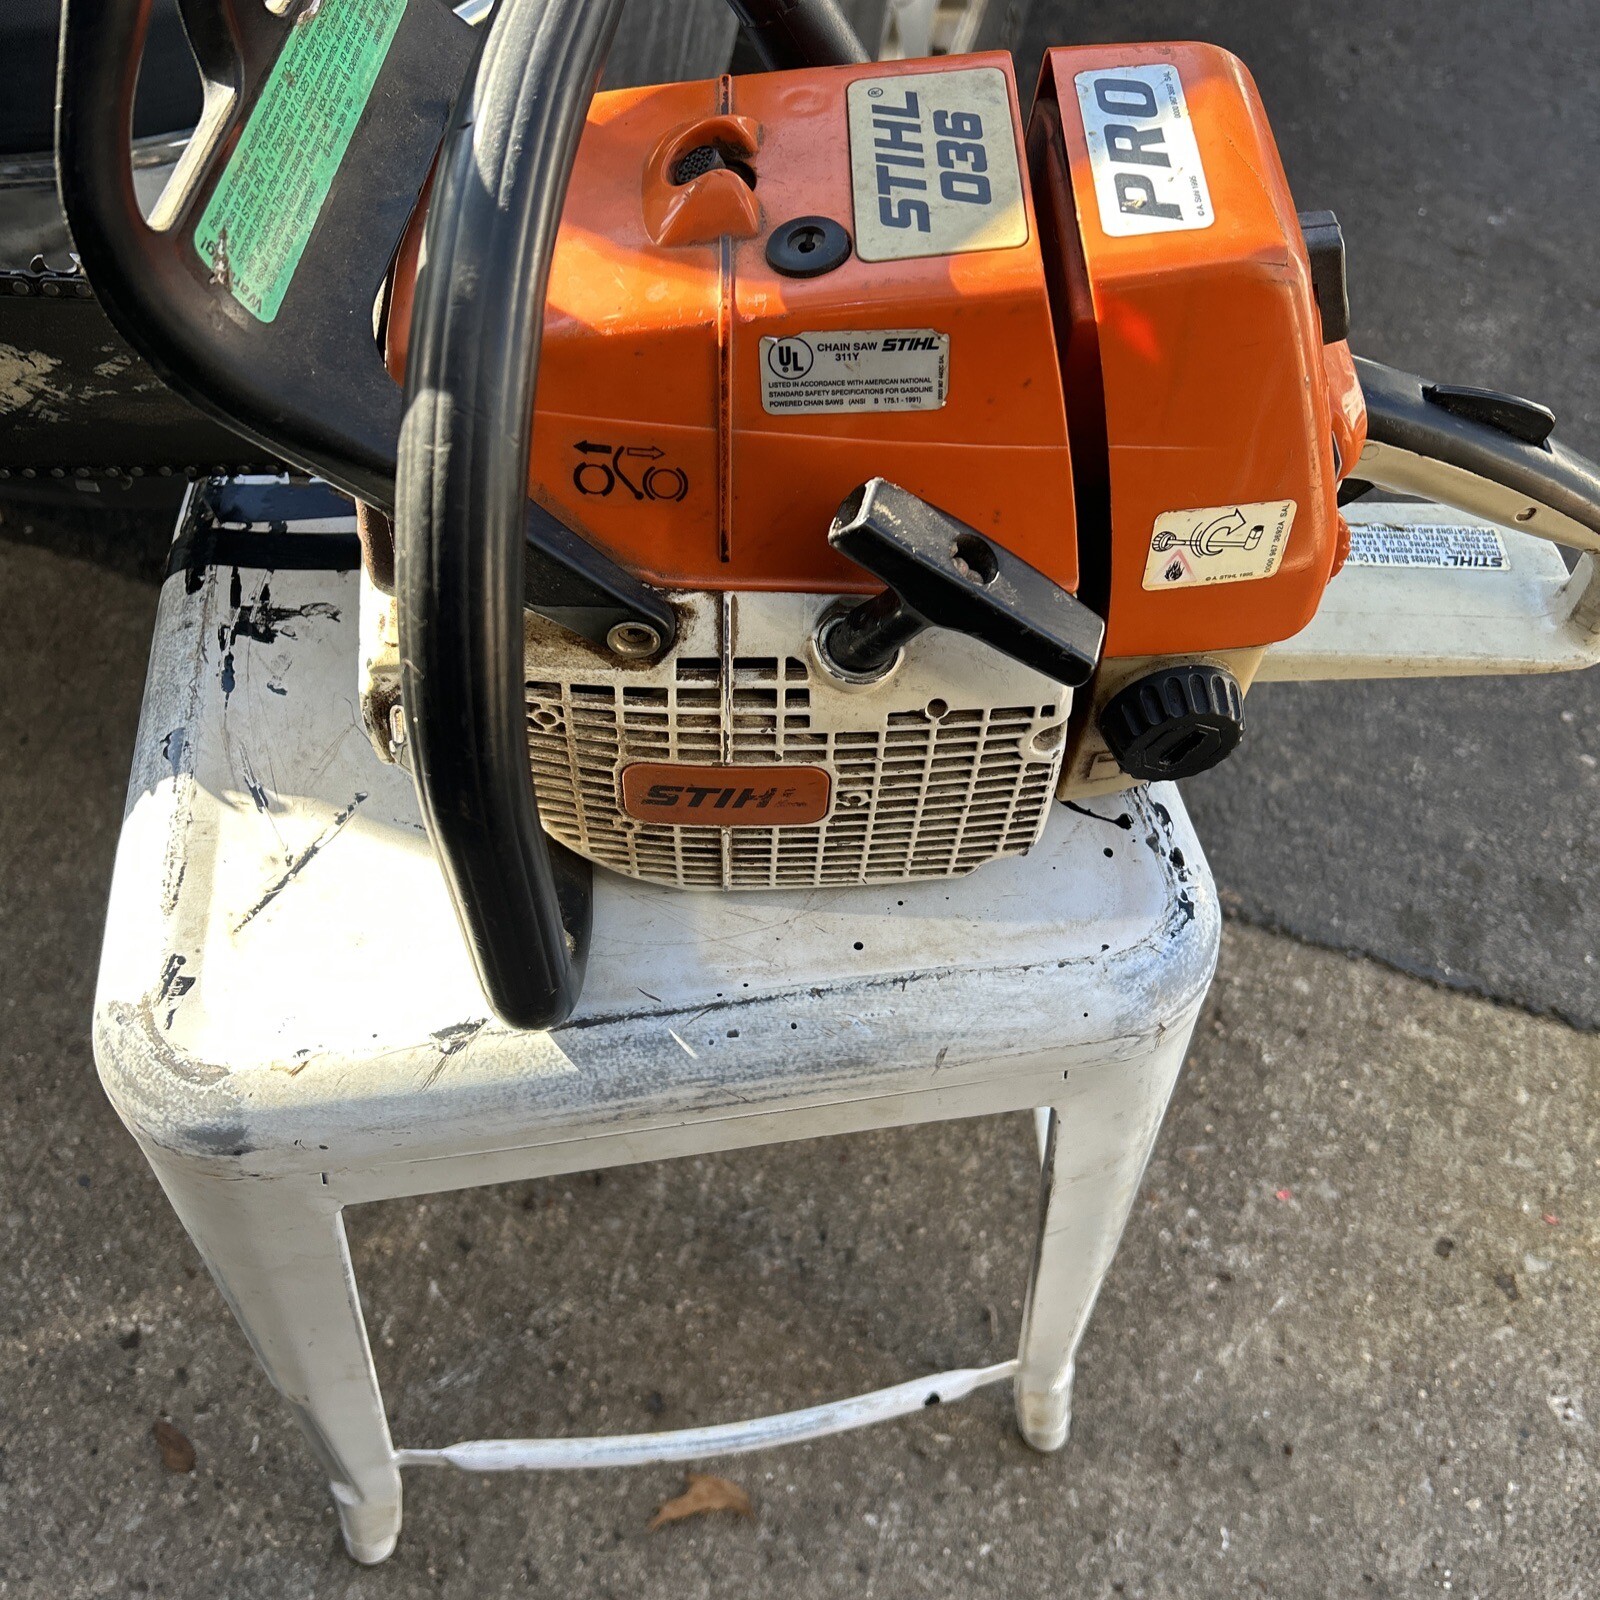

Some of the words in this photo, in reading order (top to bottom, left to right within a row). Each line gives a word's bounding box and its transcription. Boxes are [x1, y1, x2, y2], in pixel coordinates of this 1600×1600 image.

[314, 19, 324, 37] use
[328, 5, 342, 30] chain
[349, 17, 361, 39] back
[334, 19, 348, 44] Avoid
[357, 30, 367, 47] the
[303, 33, 318, 58] injury
[318, 41, 325, 52] 2
[342, 35, 353, 54] and
[311, 47, 322, 66] RM
[339, 51, 347, 65] up
[345, 43, 362, 76] operate
[308, 62, 316, 75] or
[323, 61, 342, 98] suddenly
[331, 78, 346, 107] hands
[277, 95, 288, 114] risk
[290, 101, 298, 113] 2
[298, 86, 317, 123] kickback
[316, 93, 327, 114] kick
[325, 102, 336, 121] two
[263, 109, 281, 142] reduce
[283, 108, 294, 127] RM
[312, 109, 320, 122] to
[208, 202, 225, 231] Read
[220, 184, 233, 207] and
[229, 159, 246, 188] follow
[241, 149, 250, 165] all
[246, 123, 264, 155] safety
[258, 79, 285, 129] precautions
[284, 38, 304, 74] Owner's
[291, 119, 303, 138] low
[305, 118, 316, 137] bar
[319, 118, 329, 137] use
[258, 137, 268, 154] To
[271, 123, 288, 155] Picco)
[299, 132, 310, 150] the
[306, 132, 324, 167] Always
[1094, 78, 1183, 221] PRO
[275, 134, 296, 174] available
[289, 147, 304, 175] cause
[933, 110, 991, 205] 036
[236, 175, 250, 200] fatal
[253, 171, 265, 192] PM
[265, 168, 280, 196] other
[282, 172, 293, 192] can
[1189, 175, 1199, 188] 1995
[232, 196, 241, 211] or
[240, 188, 257, 220] STIHL
[262, 193, 270, 206] or
[273, 188, 285, 210] This
[286, 185, 300, 209] fatal
[1193, 190, 1202, 202] Stihl
[232, 214, 245, 237] and
[251, 201, 267, 229] pitch
[269, 214, 287, 250] serious
[224, 233, 236, 254] bar
[235, 223, 257, 265] sprocket
[254, 236, 266, 257] any
[265, 246, 274, 260] in
[266, 270, 278, 294] wear
[275, 253, 287, 274] eye
[282, 234, 293, 255] and
[290, 220, 299, 238] ear
[202, 239, 263, 314] Warg!
[254, 255, 269, 285] result
[817, 343, 851, 352] CHAIN
[854, 342, 877, 351] SAW
[835, 352, 859, 361] 311Y
[779, 346, 804, 371] UL
[849, 398, 866, 406] (ANSI
[1264, 557, 1274, 573] 0000
[1269, 545, 1278, 556] 967
[1280, 503, 1290, 518] SAL
[1370, 553, 1376, 562] &
[1378, 553, 1388, 563] AG
[1391, 553, 1408, 563] Stihl
[1411, 554, 1441, 565] Andreas
[641, 785, 807, 808] STIH
